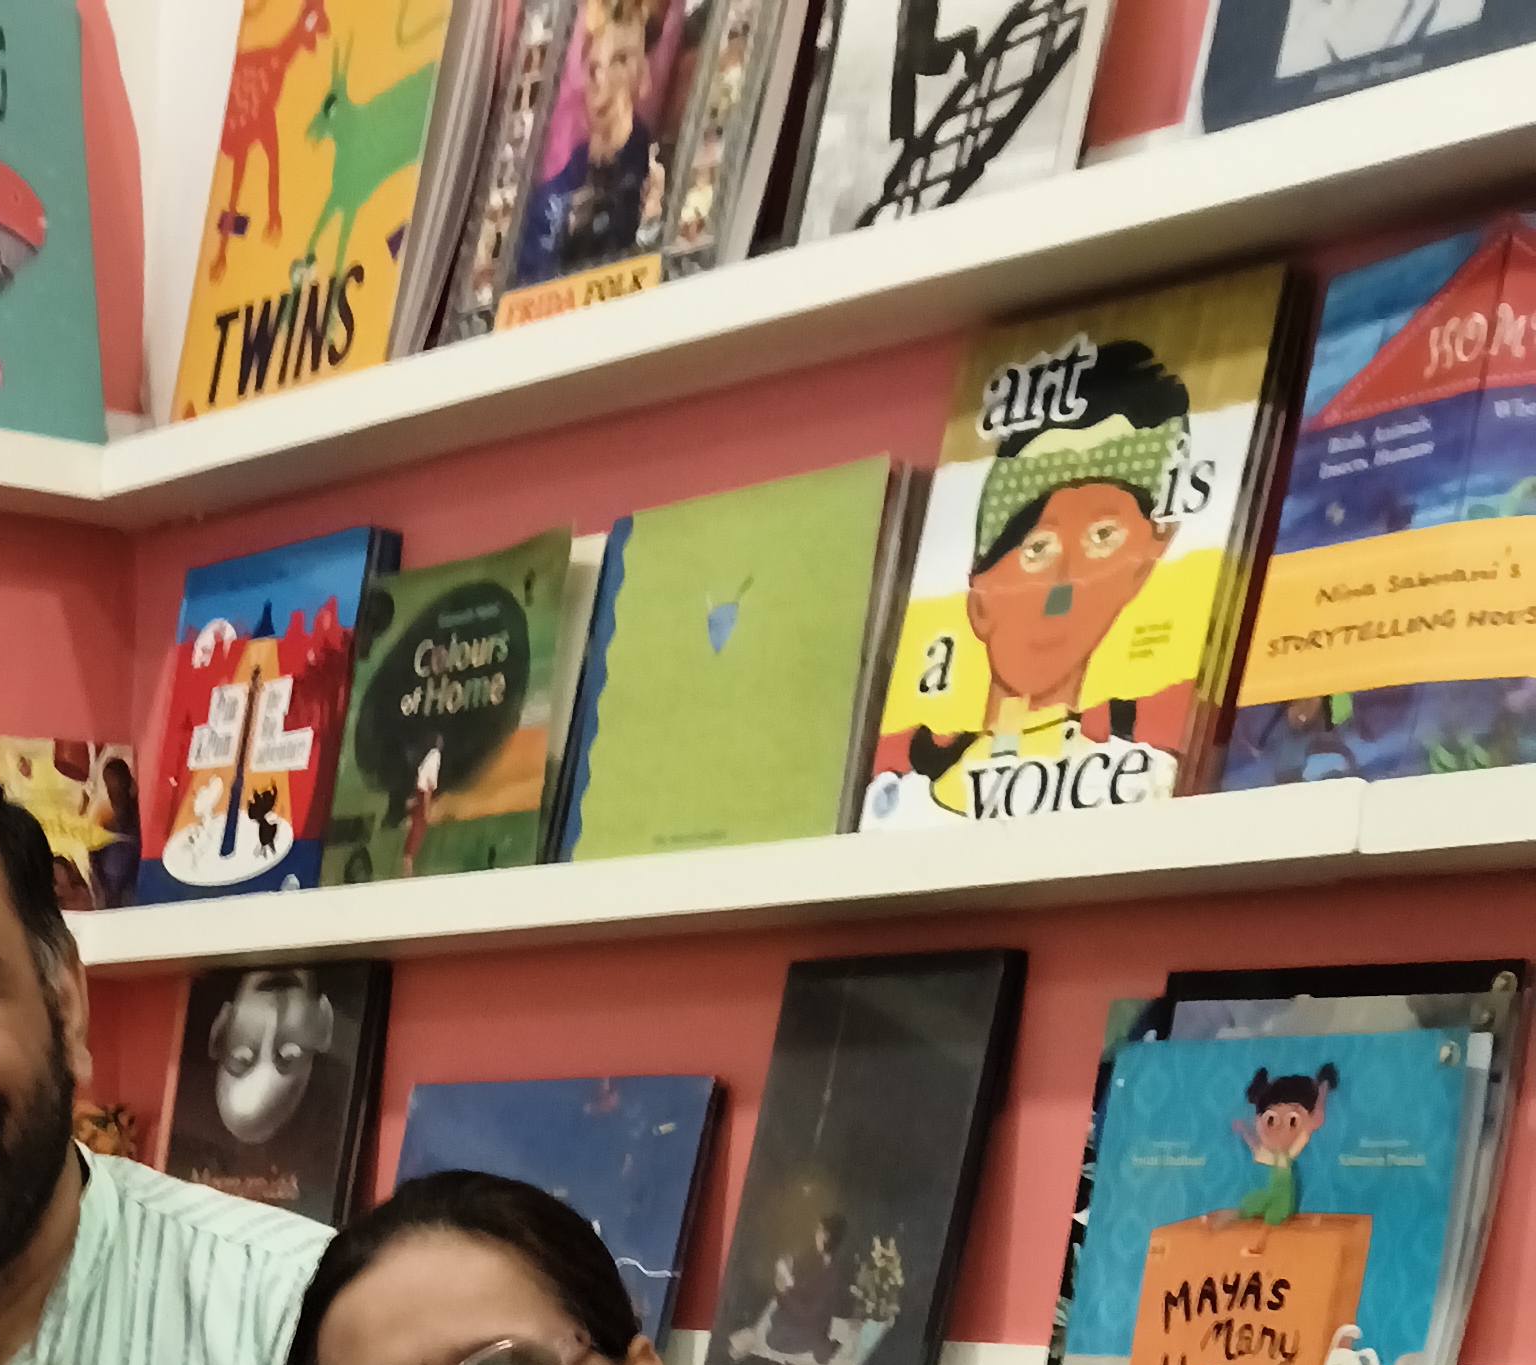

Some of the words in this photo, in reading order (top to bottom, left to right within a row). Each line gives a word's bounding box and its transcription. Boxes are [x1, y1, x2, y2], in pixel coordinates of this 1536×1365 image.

[207, 264, 365, 406] TWINS
[981, 338, 1096, 437] art
[1162, 435, 1216, 519] is
[414, 630, 511, 678] Colours
[919, 635, 955, 695] a
[1267, 608, 1457, 658] STORYTELLING
[1466, 605, 1536, 628] HOUS
[400, 686, 423, 716] of
[423, 672, 506, 716] Home
[967, 727, 1153, 820] voice
